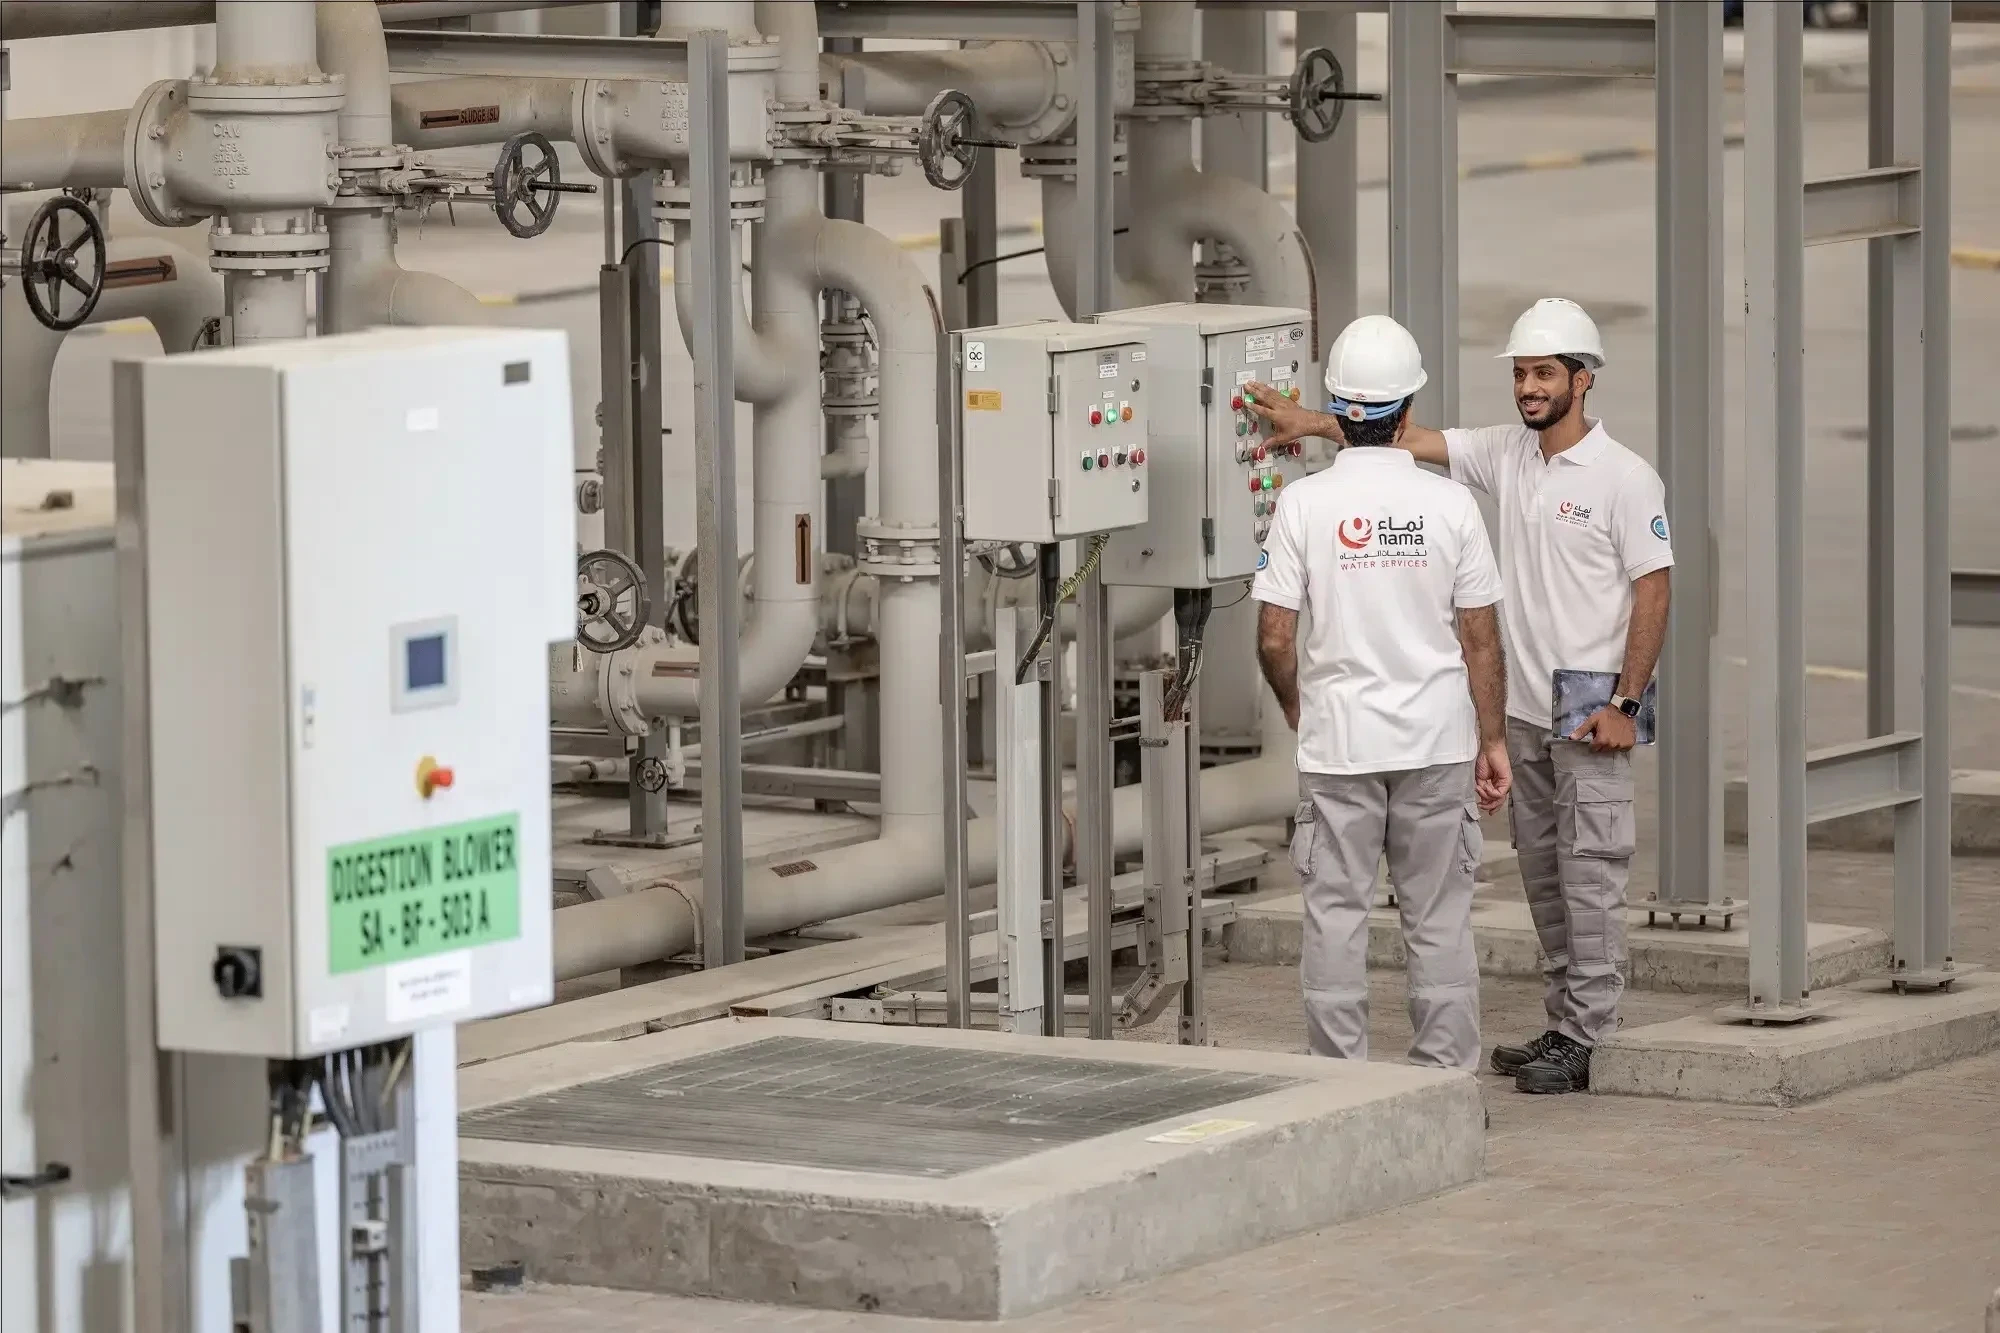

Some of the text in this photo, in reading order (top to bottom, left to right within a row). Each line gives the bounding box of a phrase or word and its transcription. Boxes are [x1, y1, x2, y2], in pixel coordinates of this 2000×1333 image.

[460, 108, 486, 124] SLUDGE
[213, 123, 240, 138] CAV
[969, 351, 983, 361] QC
[1573, 510, 1589, 519] nama
[1574, 505, 1592, 513] نماء
[1377, 515, 1424, 533] نماء
[1378, 533, 1425, 546] nama
[1340, 559, 1429, 571] WATER SERVICES
[331, 826, 517, 904] DIGESTION BLOWER
